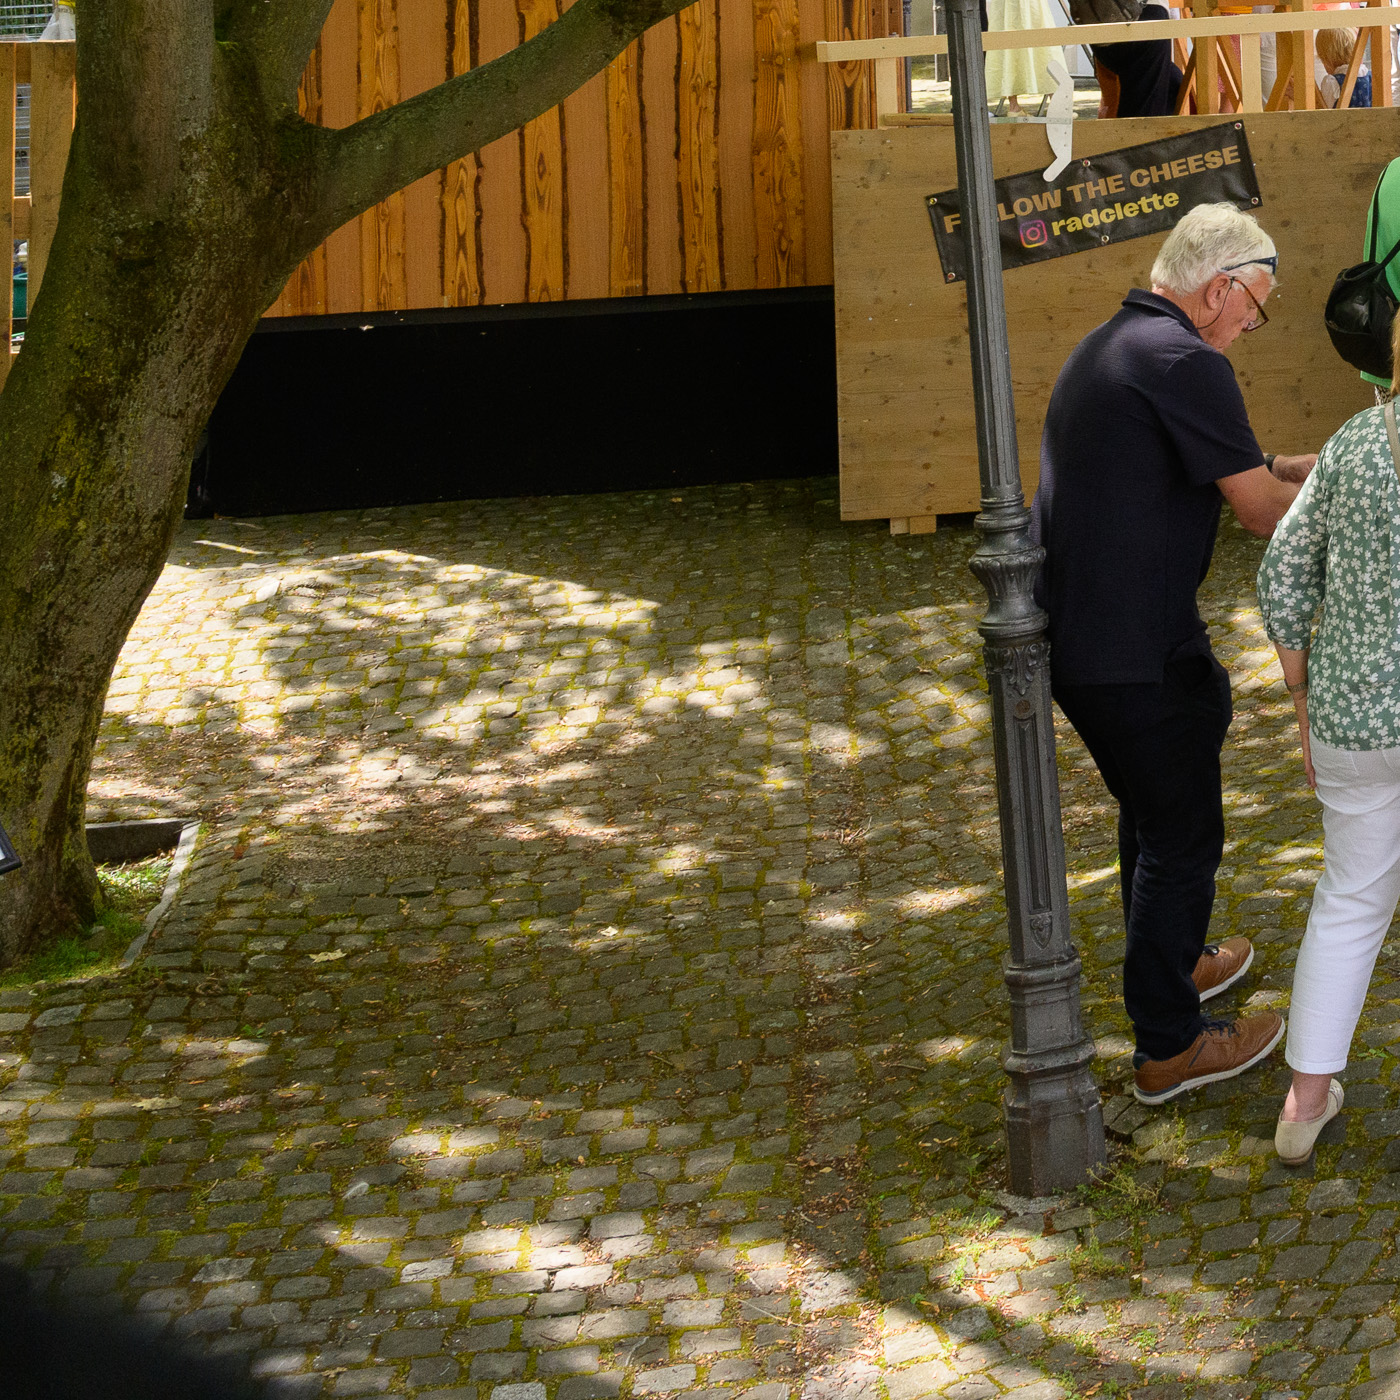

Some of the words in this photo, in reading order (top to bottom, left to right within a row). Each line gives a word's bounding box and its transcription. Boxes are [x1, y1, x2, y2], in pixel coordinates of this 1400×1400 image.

[943, 188, 1062, 234] FLOW
[1066, 173, 1126, 203] THE
[1130, 145, 1241, 188] CHEESE
[1051, 192, 1180, 236] radclette
